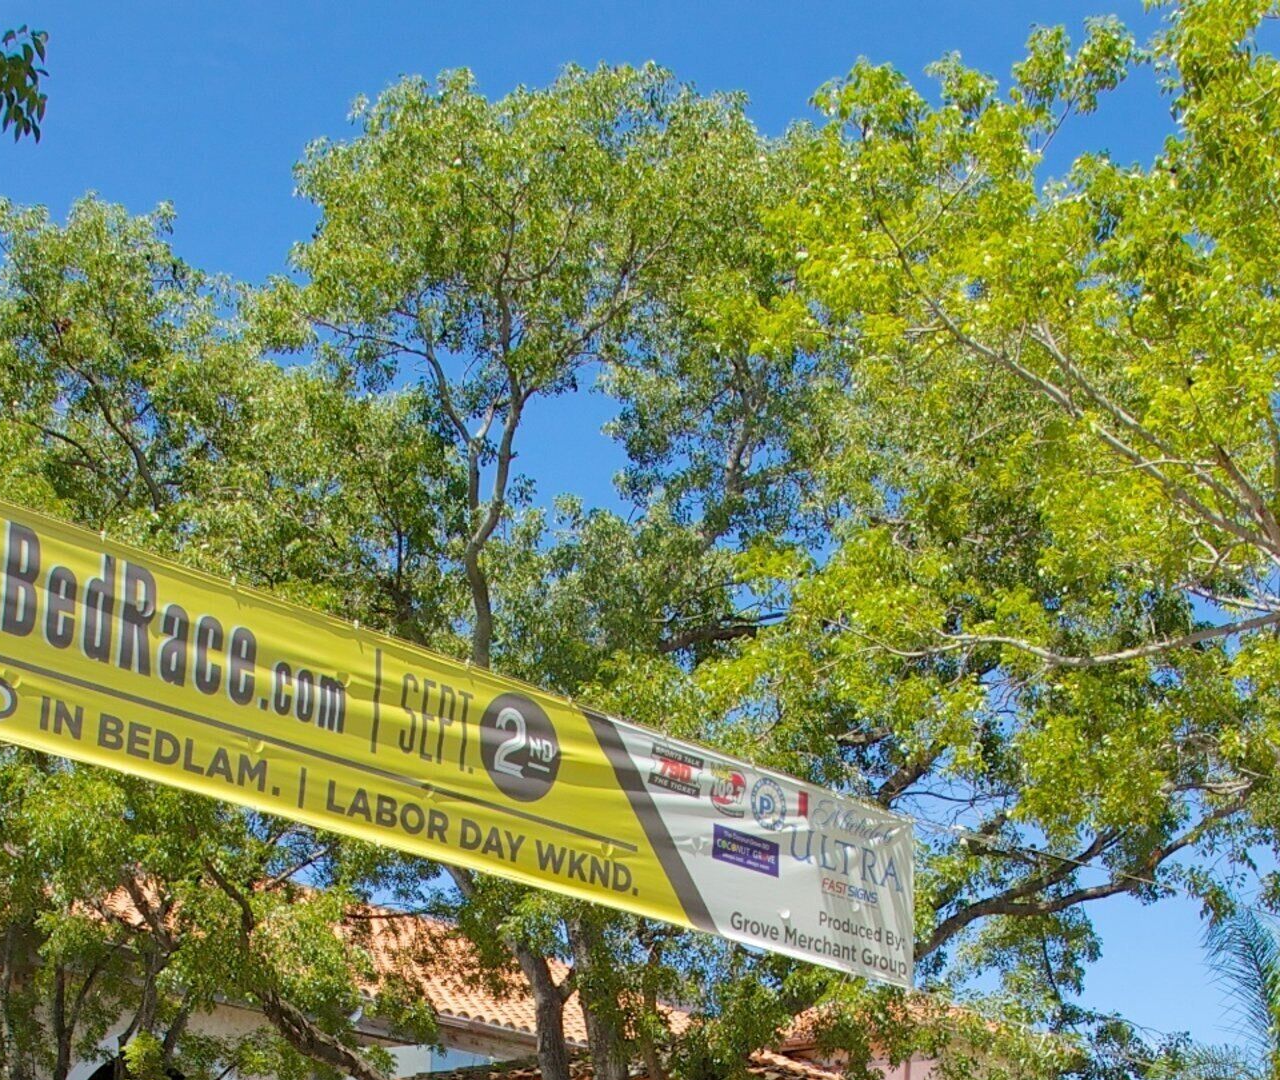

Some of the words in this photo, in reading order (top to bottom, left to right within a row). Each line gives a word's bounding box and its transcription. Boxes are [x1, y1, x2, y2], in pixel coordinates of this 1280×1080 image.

[38, 695, 84, 741] IN
[98, 714, 280, 796] BEDLAM.
[398, 673, 474, 774] SEPT.
[654, 775, 669, 788] THE
[326, 779, 448, 845] LABOR
[459, 817, 526, 863] DAY
[535, 840, 640, 897] WKND.
[789, 825, 905, 893] ULTRA
[730, 911, 780, 940] Grove
[784, 926, 857, 963] Merchant
[861, 948, 908, 978] Group
[819, 911, 882, 943] Produced
[887, 931, 906, 951] By:
